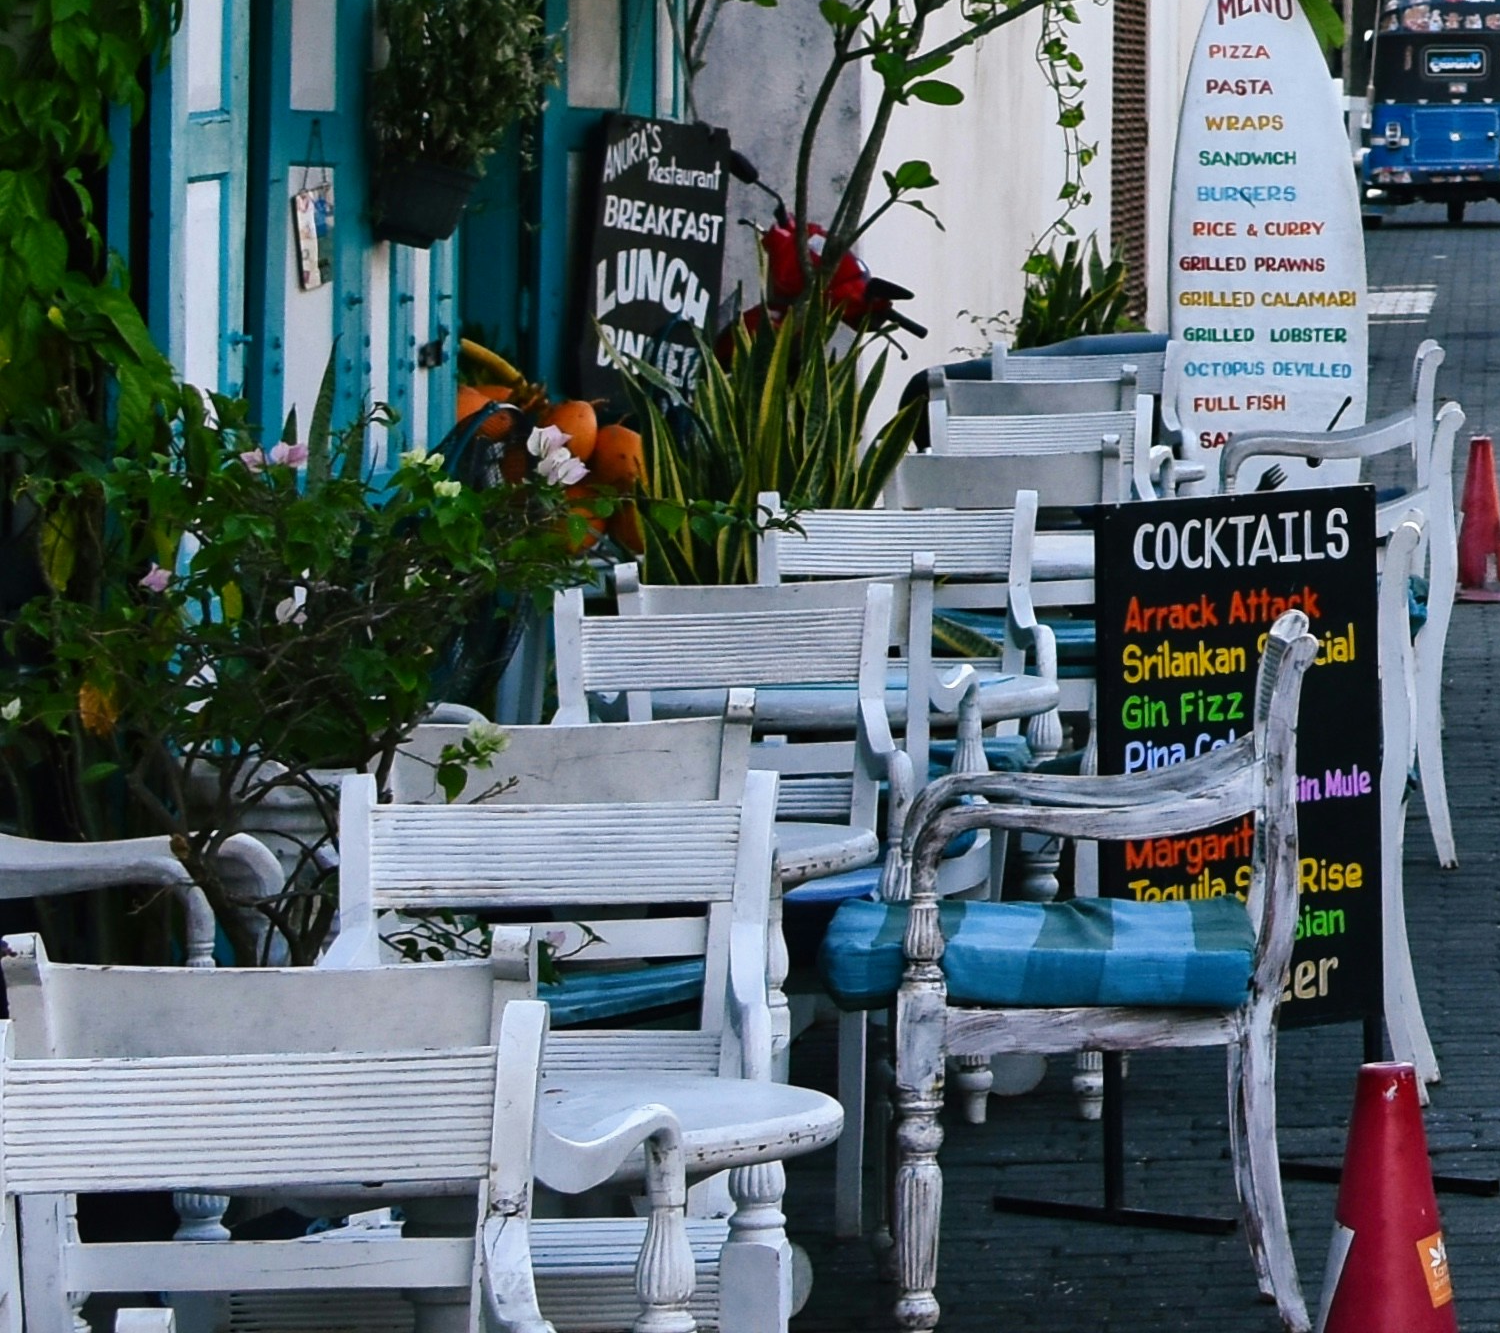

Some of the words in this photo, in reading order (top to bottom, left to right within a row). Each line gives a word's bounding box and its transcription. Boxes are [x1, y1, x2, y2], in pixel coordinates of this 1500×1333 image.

[1208, 44, 1271, 59] PIZZA
[1206, 79, 1273, 95] PASTA
[1205, 115, 1284, 131] WRAPS
[602, 123, 662, 183] ANURA'S
[1198, 150, 1297, 167] SANDWICH
[648, 156, 722, 191] Restaurant
[1196, 186, 1297, 202] BURGERS
[602, 194, 723, 245] BREAKFAST
[1192, 221, 1237, 237] RICE
[1246, 223, 1258, 237] &
[1264, 221, 1326, 236] CURRY
[1179, 256, 1246, 272] GRILLED
[1254, 257, 1326, 272] PRAWNS
[596, 248, 711, 329] LUNCH
[1179, 291, 1255, 307] GRILLED
[1261, 290, 1357, 307] CALAMARI
[1183, 326, 1255, 343] GRILLED
[1270, 328, 1348, 343] LOBSTER
[1184, 361, 1265, 377] OCTOPUS
[1272, 361, 1352, 378] DEVILLED
[1193, 395, 1240, 412] FULL
[1246, 395, 1286, 411] FISH
[1133, 507, 1350, 570] COCKTAILS
[1124, 593, 1219, 634] Arrack
[1122, 638, 1246, 684] Srilankan
[1121, 693, 1170, 730] Gin
[1180, 690, 1245, 726] Fizz
[1124, 740, 1186, 775] Pina
[1324, 764, 1372, 799] Mule
[1124, 816, 1256, 874] Margarit
[1297, 857, 1363, 895] Rise
